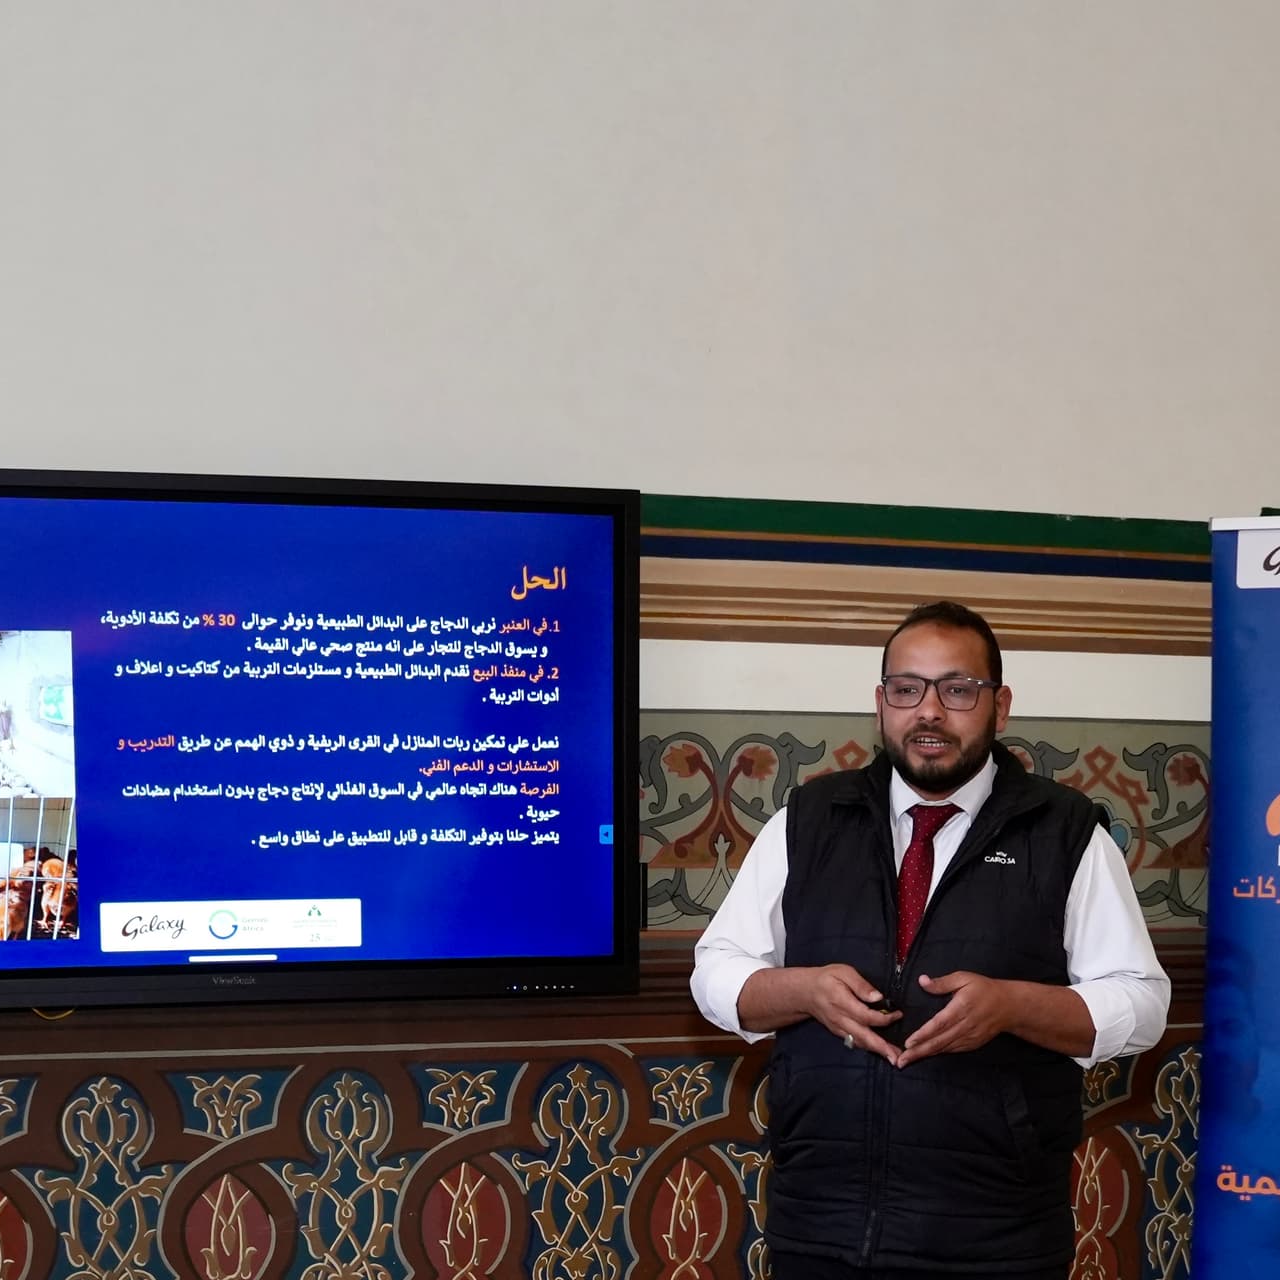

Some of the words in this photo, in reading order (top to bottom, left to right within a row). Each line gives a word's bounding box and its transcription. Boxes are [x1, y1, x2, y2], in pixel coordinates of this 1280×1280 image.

[512, 566, 567, 600] الحل
[149, 611, 180, 624] تكلفة
[183, 616, 201, 629] من
[218, 614, 236, 626] 30
[280, 612, 314, 631] ونوفر
[317, 614, 364, 630] الطبيعية
[367, 616, 404, 631] البدائل
[430, 617, 469, 634] الدجاج
[472, 618, 497, 635] نربي
[499, 619, 530, 633] العنبر
[255, 637, 289, 653] القيمة
[292, 638, 318, 656] عالي
[320, 643, 354, 656] صحي
[356, 641, 383, 657] منتج
[427, 640, 462, 656] للتجار
[464, 641, 502, 659] الدجاج
[505, 642, 538, 658] يسوق
[540, 646, 548, 657] و
[114, 665, 124, 676] و
[125, 659, 163, 674] اعلاف
[165, 665, 174, 677] و
[176, 660, 221, 677] كتاكيت
[223, 665, 241, 678] من
[243, 661, 281, 678] التربية
[283, 663, 342, 679] مستلزمات
[344, 667, 353, 678] و
[355, 663, 402, 679] الطبيعية
[405, 664, 441, 680] البدائل
[444, 663, 471, 682] نقدم
[472, 665, 498, 682] البيع
[500, 664, 527, 677] منفذ
[529, 665, 545, 683] في
[489, 688, 525, 705] التربية
[527, 687, 560, 704] أدوات
[117, 739, 126, 750] و
[128, 735, 176, 752] التدريب
[178, 735, 212, 752] طريق
[214, 738, 233, 751] عن
[235, 735, 266, 752] الهمم
[269, 734, 295, 752] ذوي
[297, 739, 305, 750] و
[307, 735, 346, 752] الريفية
[348, 735, 381, 751] القرى
[383, 734, 400, 753] في
[401, 735, 441, 751] المنازل
[443, 736, 471, 751] ربات
[473, 735, 506, 752] تمكين
[532, 736, 560, 751] نعمل
[453, 760, 485, 776] الدعم
[486, 763, 494, 774] و
[497, 760, 560, 774] الاستشارات
[122, 784, 171, 797] مضادات
[173, 784, 223, 801] استخدام
[225, 785, 256, 799] بدون
[257, 783, 290, 800] دجاج
[328, 782, 366, 800] الغذائي
[369, 783, 406, 799] السوق
[408, 782, 423, 799] في
[425, 783, 458, 799] عالمي
[460, 783, 487, 797] اتجاه
[489, 783, 518, 795] هناك
[520, 783, 560, 798] الفرصة
[526, 805, 561, 823] حيوية
[259, 831, 289, 848] واسع
[291, 830, 321, 845] نطاق
[347, 830, 392, 846] للتطبيق
[394, 829, 418, 845] قابل
[419, 834, 428, 845] و
[431, 828, 467, 841] التكلفة
[468, 828, 505, 846] بتوفير
[506, 829, 530, 841] حلنا
[531, 831, 560, 845] يتميز
[121, 914, 187, 940] Galaxy
